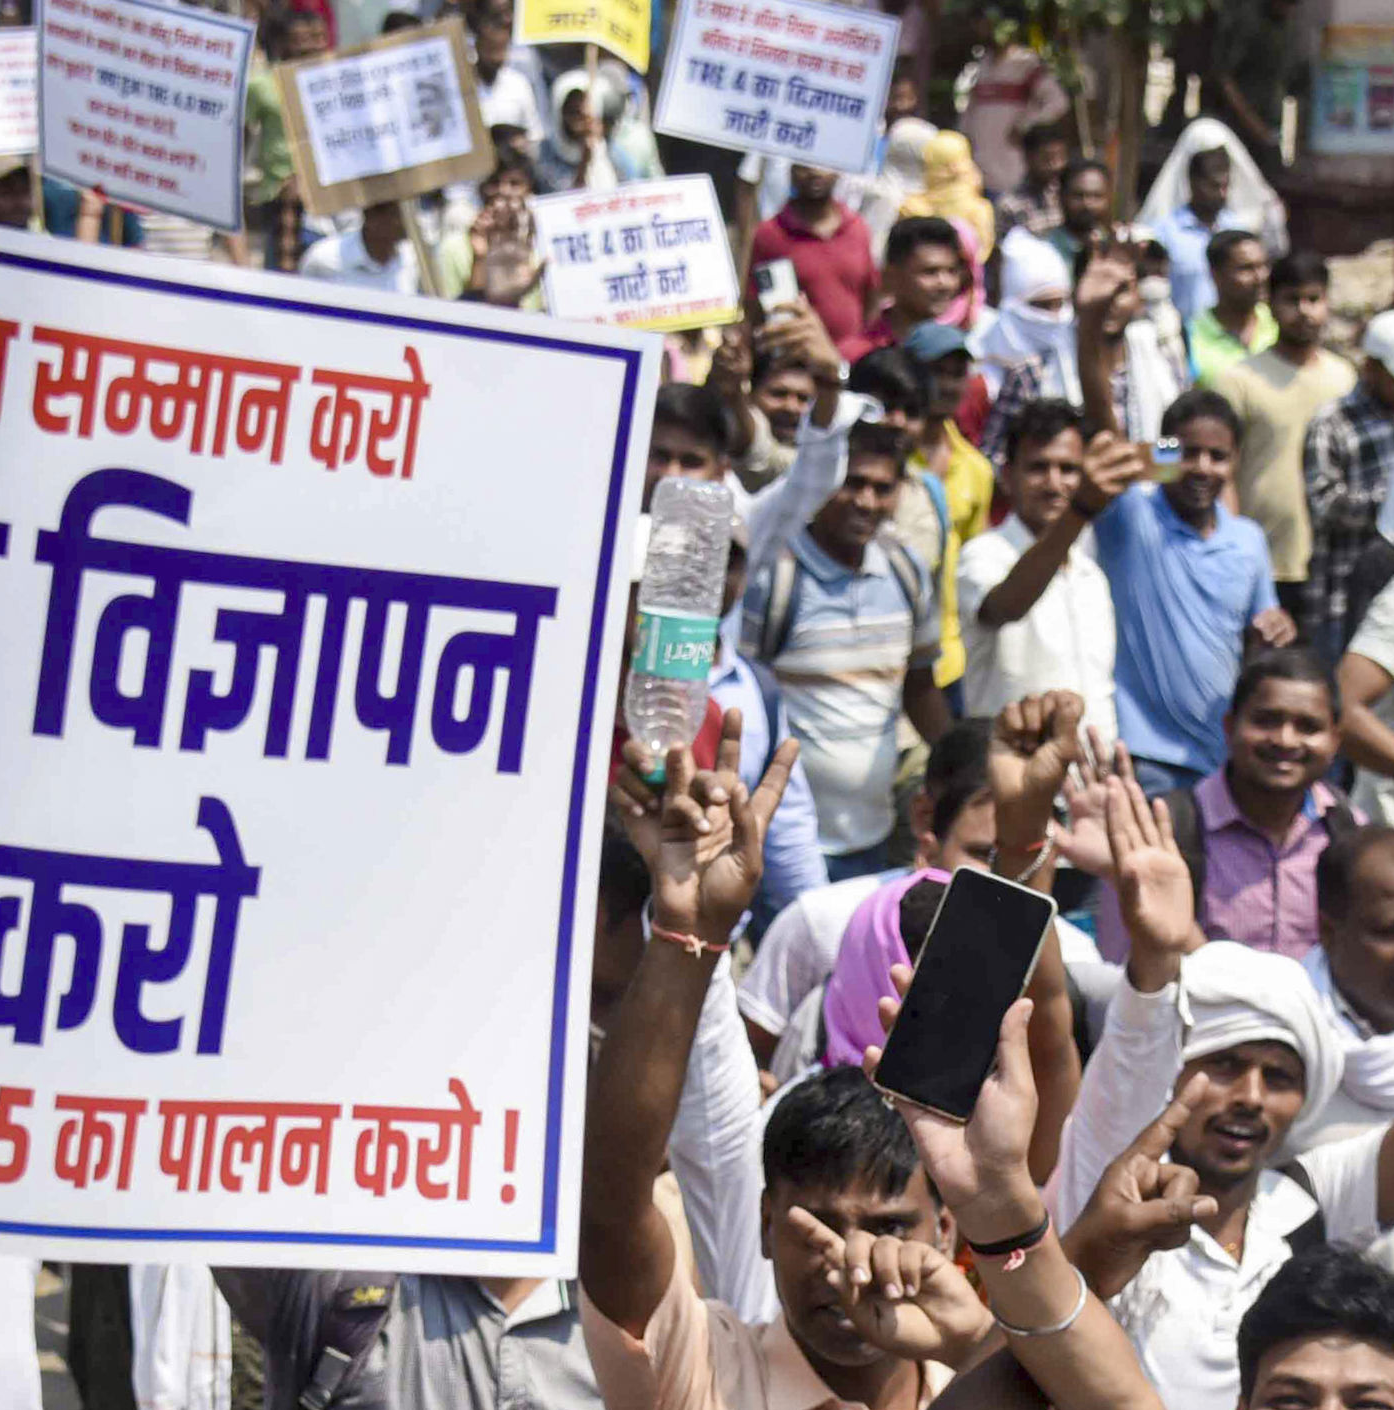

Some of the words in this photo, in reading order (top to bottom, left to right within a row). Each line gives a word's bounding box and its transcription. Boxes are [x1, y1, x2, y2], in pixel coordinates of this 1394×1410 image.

[688, 58, 725, 89] TRE
[732, 69, 746, 91] 4
[601, 229, 615, 255] 4
[31, 324, 303, 465] सम्मान
[308, 344, 433, 480] करो
[31, 467, 560, 775] विज्ञापन
[52, 1093, 150, 1192] का
[156, 1098, 344, 1196] पालन
[351, 1076, 483, 1201] करो
